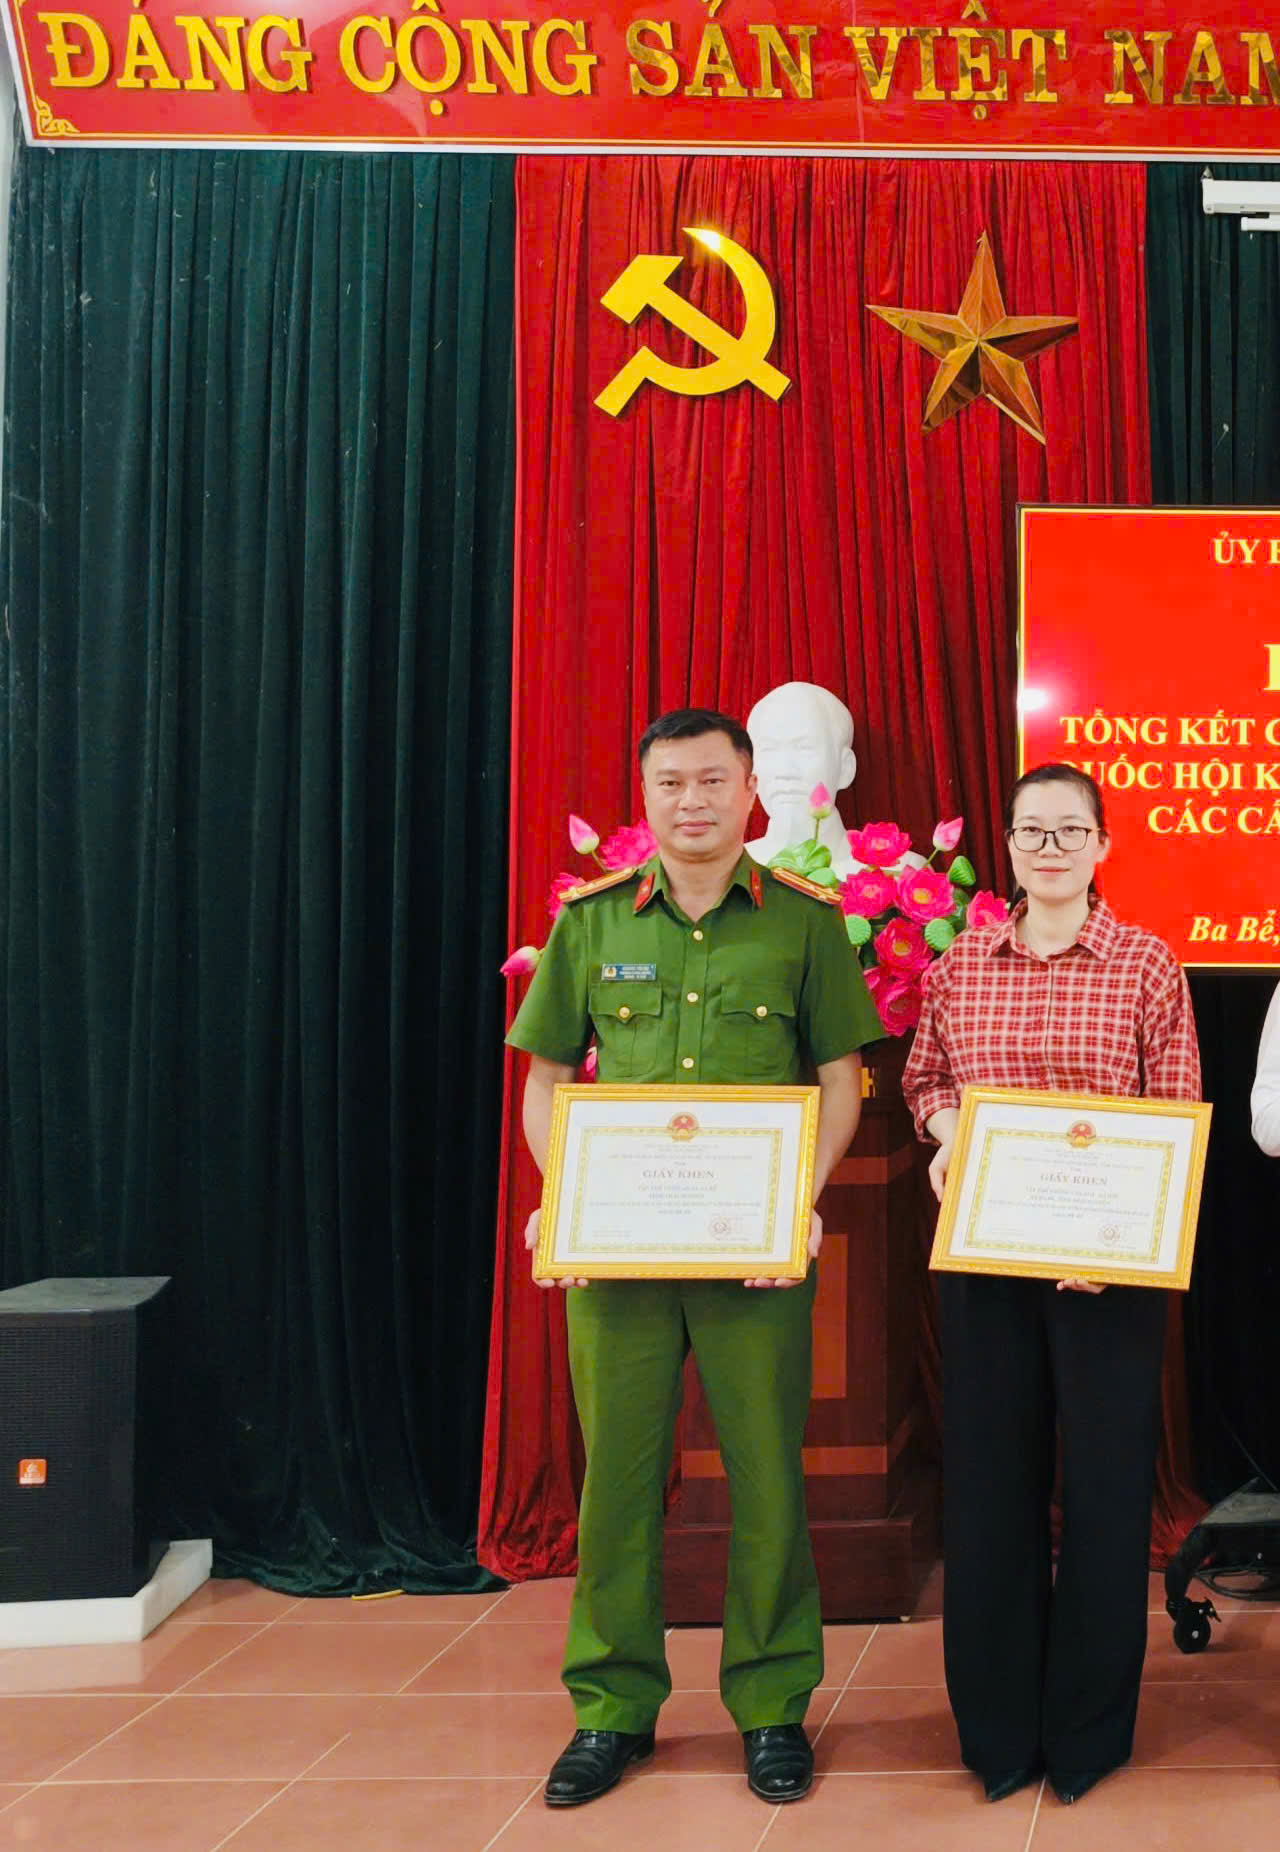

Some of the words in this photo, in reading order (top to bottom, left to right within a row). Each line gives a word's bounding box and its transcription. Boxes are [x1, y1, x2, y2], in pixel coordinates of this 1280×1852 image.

[38, 0, 312, 93] ĐẢNG
[339, 0, 598, 116] CỘNG
[626, 0, 818, 98] SẢN
[844, 0, 1066, 120] VIỆT
[1213, 531, 1260, 565] ỦY
[1059, 709, 1169, 745] TỔNG
[1178, 710, 1256, 746] KẾT
[1061, 754, 1163, 790] UỐC
[1175, 758, 1244, 797] HỘI
[1147, 799, 1227, 835] CÁC
[1188, 916, 1228, 942] Ba
[1236, 910, 1280, 946] Bể,
